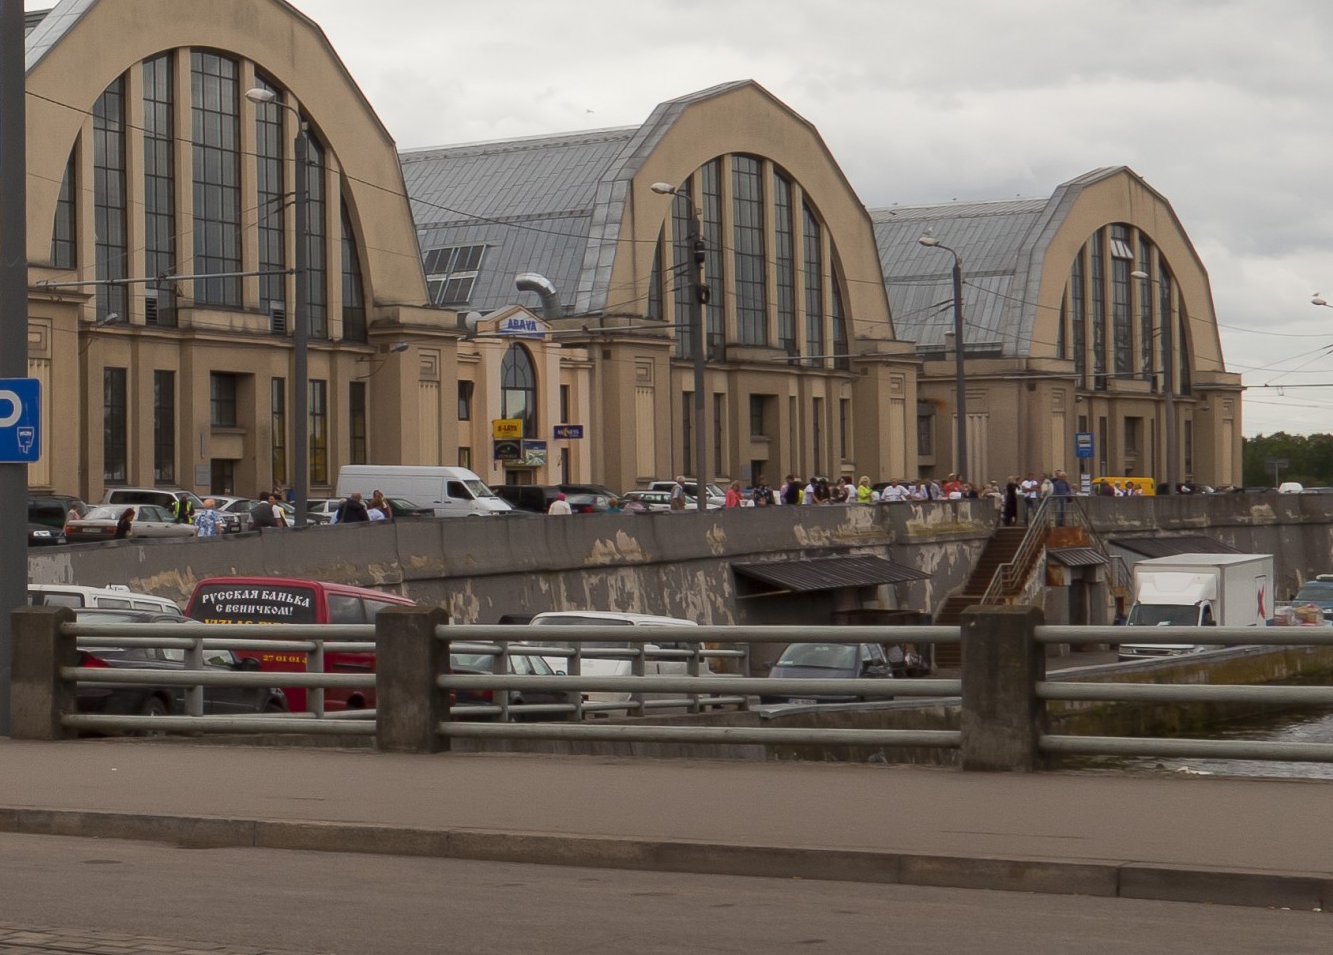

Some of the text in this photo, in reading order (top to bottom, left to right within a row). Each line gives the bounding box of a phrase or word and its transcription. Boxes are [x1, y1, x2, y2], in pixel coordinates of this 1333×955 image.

[202, 590, 310, 607] РУССКАЯ БАНЬКА
[225, 604, 293, 616] ВЕНИЧКОМ!
[275, 654, 287, 662] 01
[288, 655, 300, 663] 01
